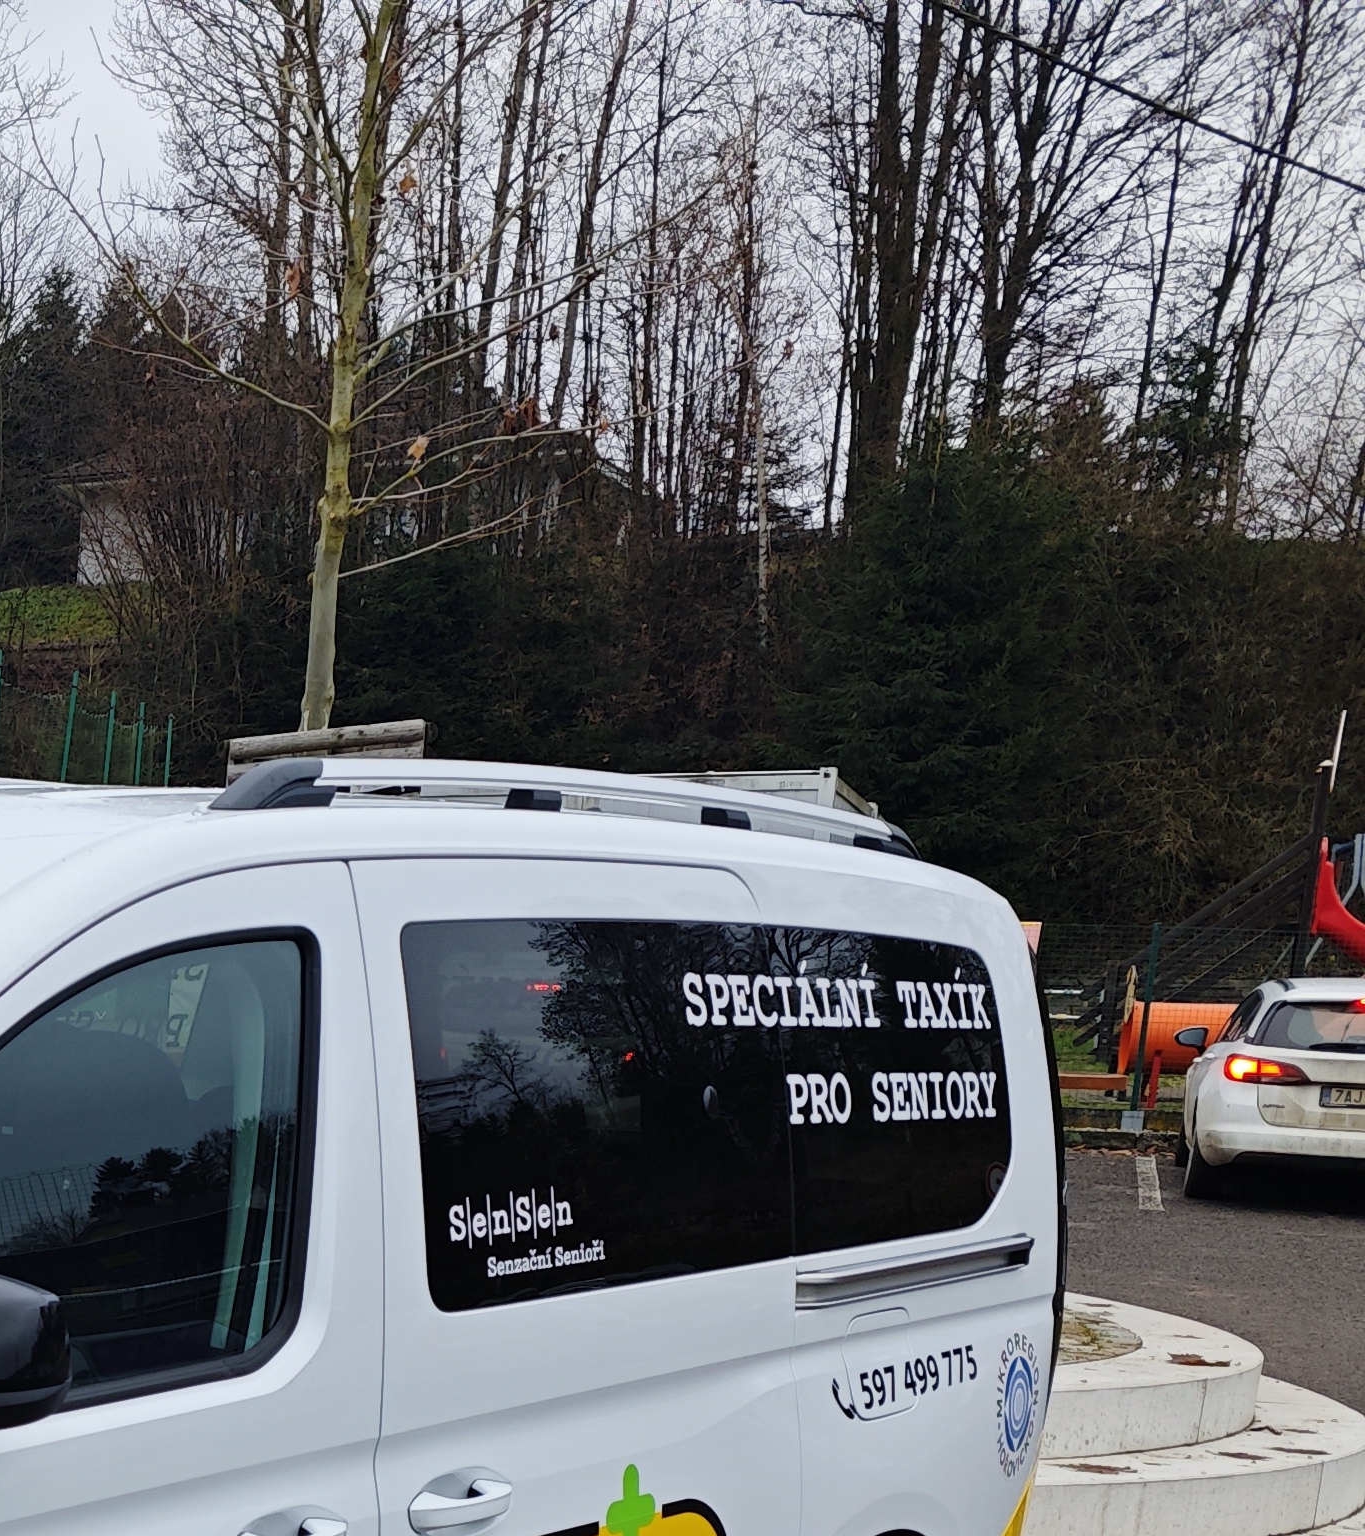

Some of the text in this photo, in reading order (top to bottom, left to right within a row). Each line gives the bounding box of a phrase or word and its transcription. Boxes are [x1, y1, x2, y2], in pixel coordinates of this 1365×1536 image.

[682, 959, 991, 1029] SPECIÁLNÍ TAXÍK
[786, 1071, 997, 1125] PRO SENIORY
[486, 1239, 606, 1277] Senzační Senioři
[859, 1344, 978, 1410] 597 499 775
[996, 1332, 1040, 1418] MIKROREGION
